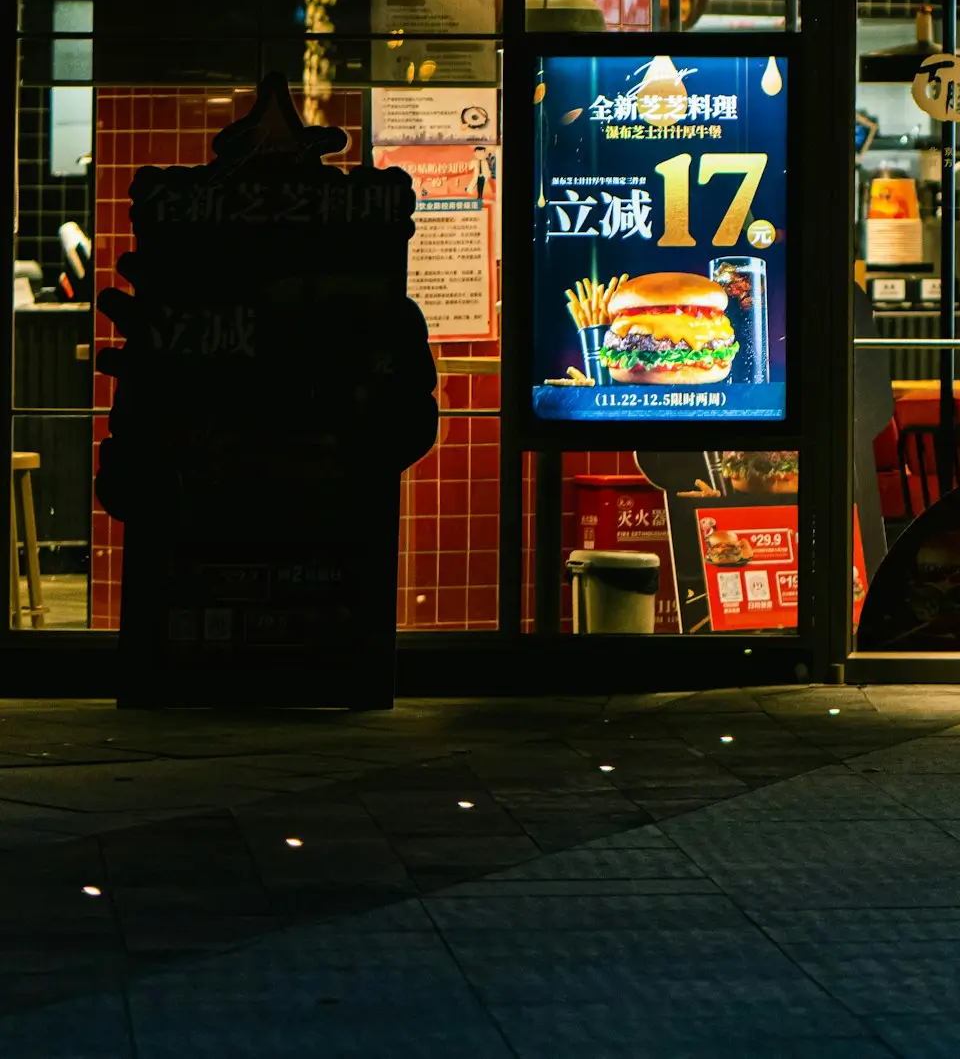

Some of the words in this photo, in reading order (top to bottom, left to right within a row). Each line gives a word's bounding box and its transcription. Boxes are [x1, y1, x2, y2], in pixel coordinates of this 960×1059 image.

[589, 94, 739, 120] 全新芝芝料理
